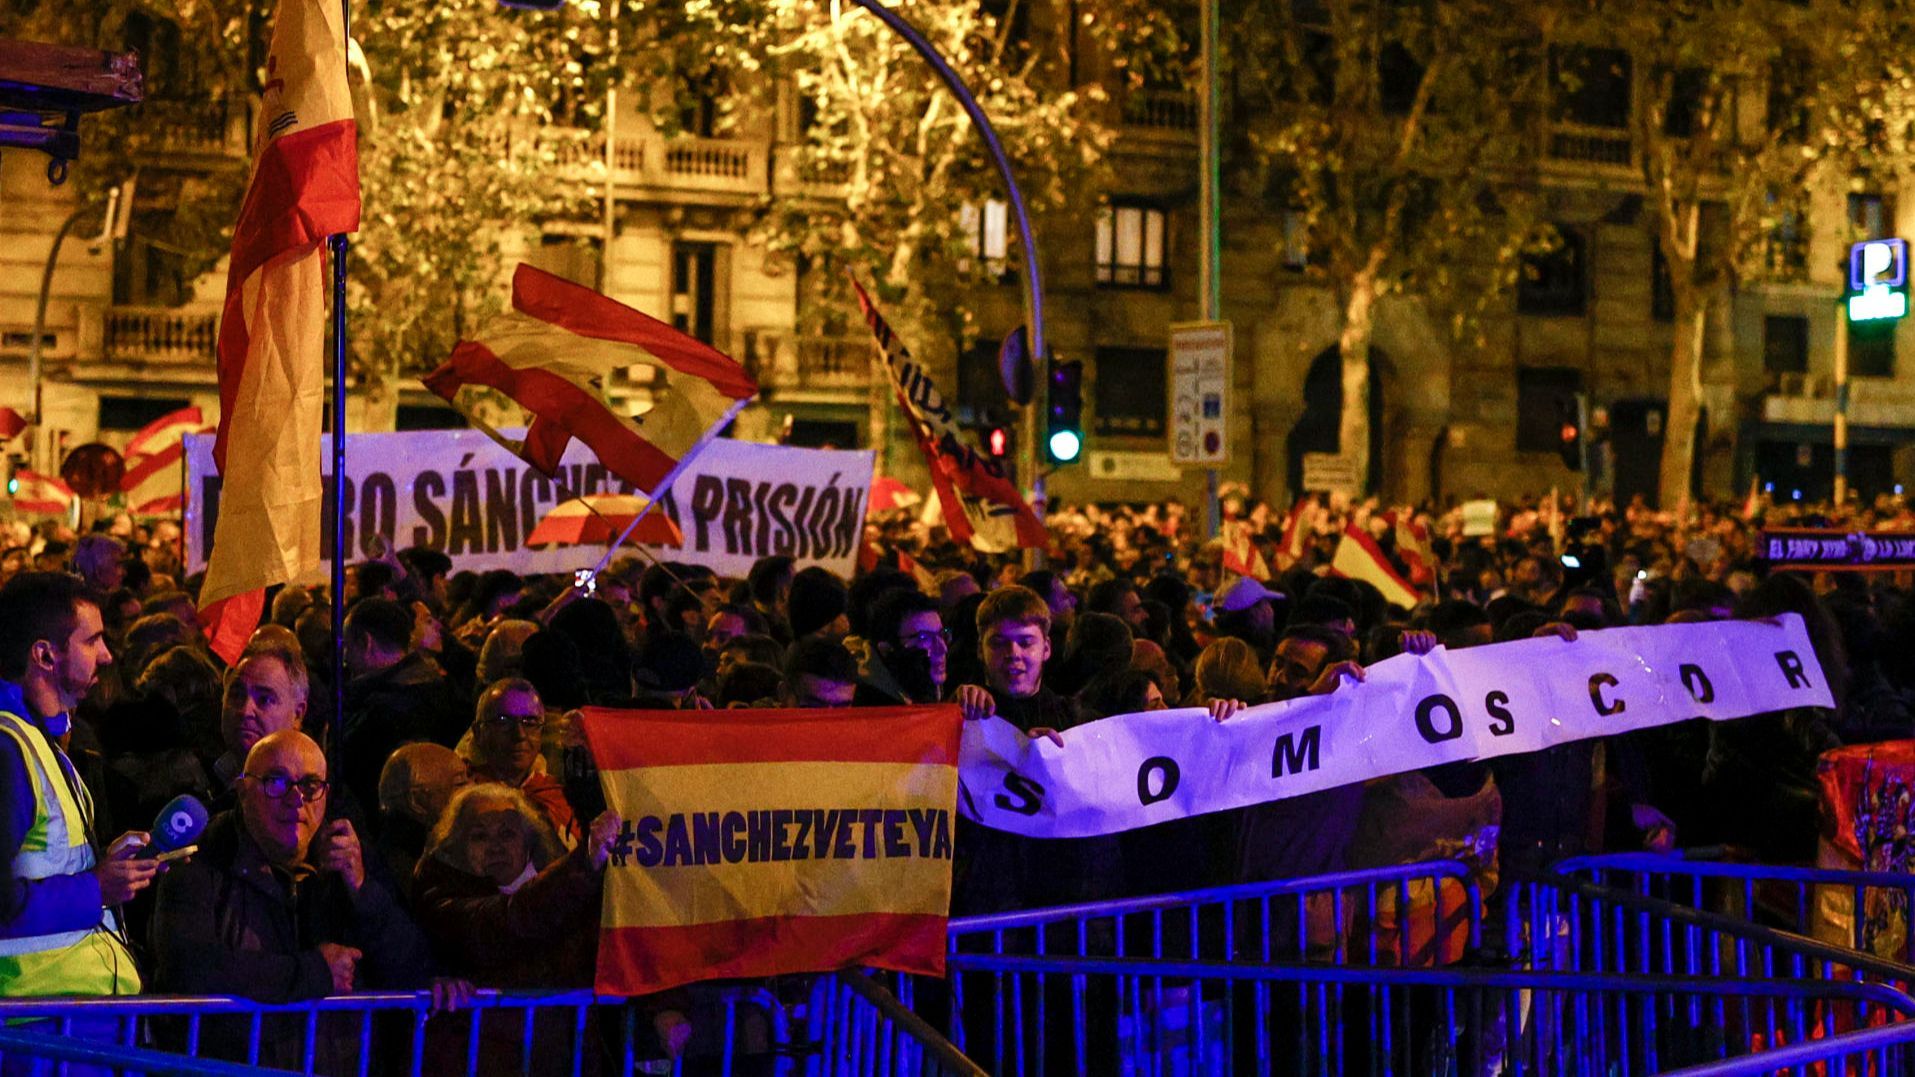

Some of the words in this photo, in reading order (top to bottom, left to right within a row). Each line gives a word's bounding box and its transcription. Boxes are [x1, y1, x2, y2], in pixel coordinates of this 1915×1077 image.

[413, 453, 638, 554] SÁNC
[691, 472, 863, 560] PRISIÓN
[608, 808, 952, 868] #SANCHEZVETEYA
